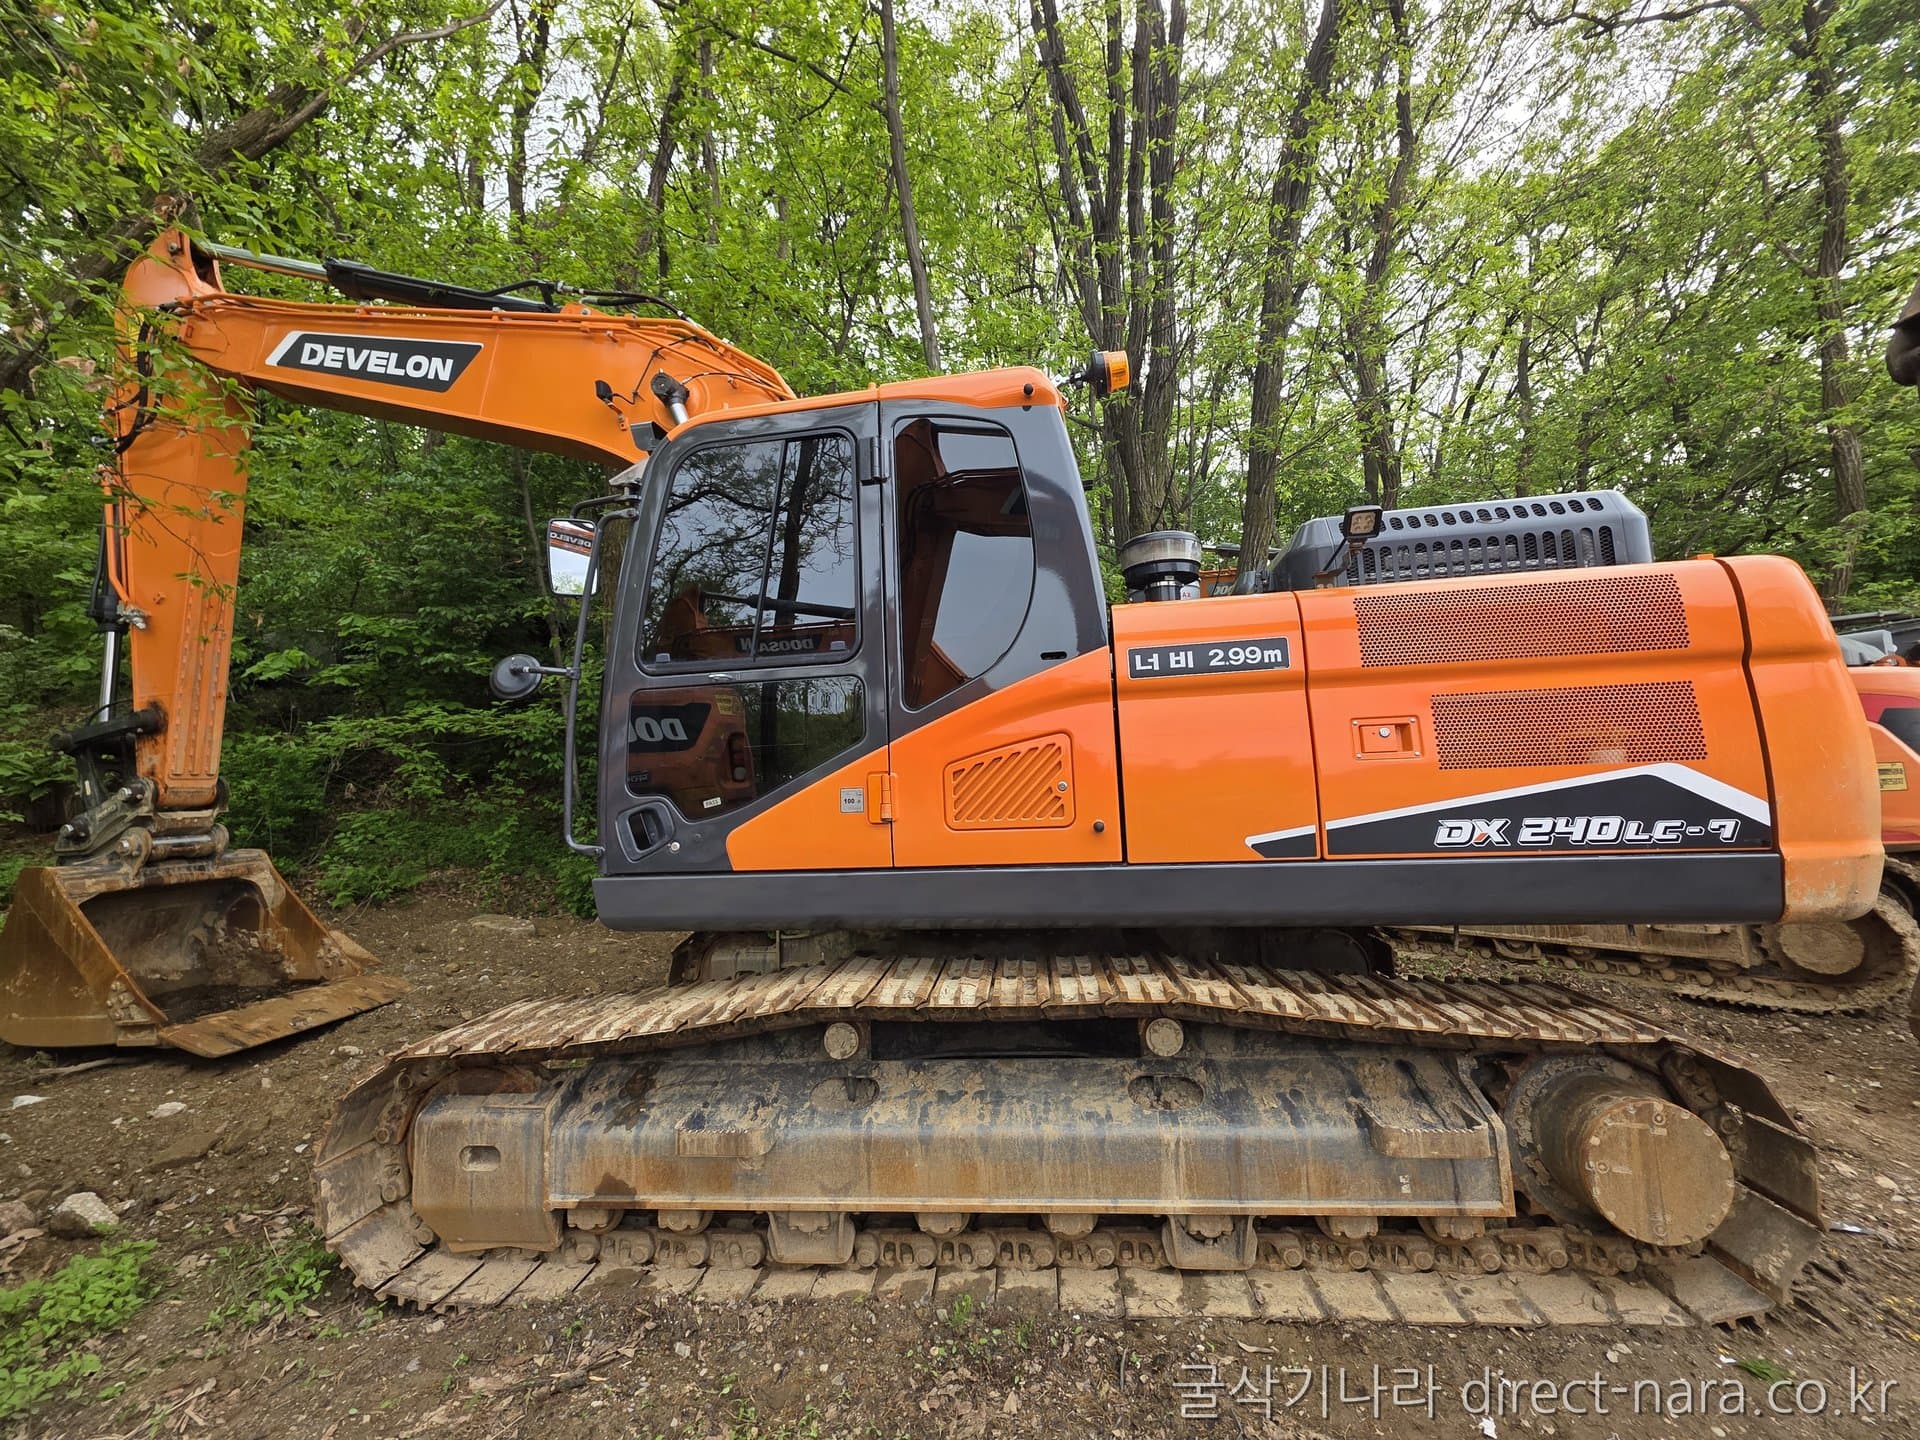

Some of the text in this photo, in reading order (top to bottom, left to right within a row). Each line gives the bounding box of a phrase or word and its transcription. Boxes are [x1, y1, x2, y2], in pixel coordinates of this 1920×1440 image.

[300, 342, 453, 381] DEVELON
[1208, 646, 1282, 667] 2.99m
[1434, 815, 1740, 847] DX 240LC-7
